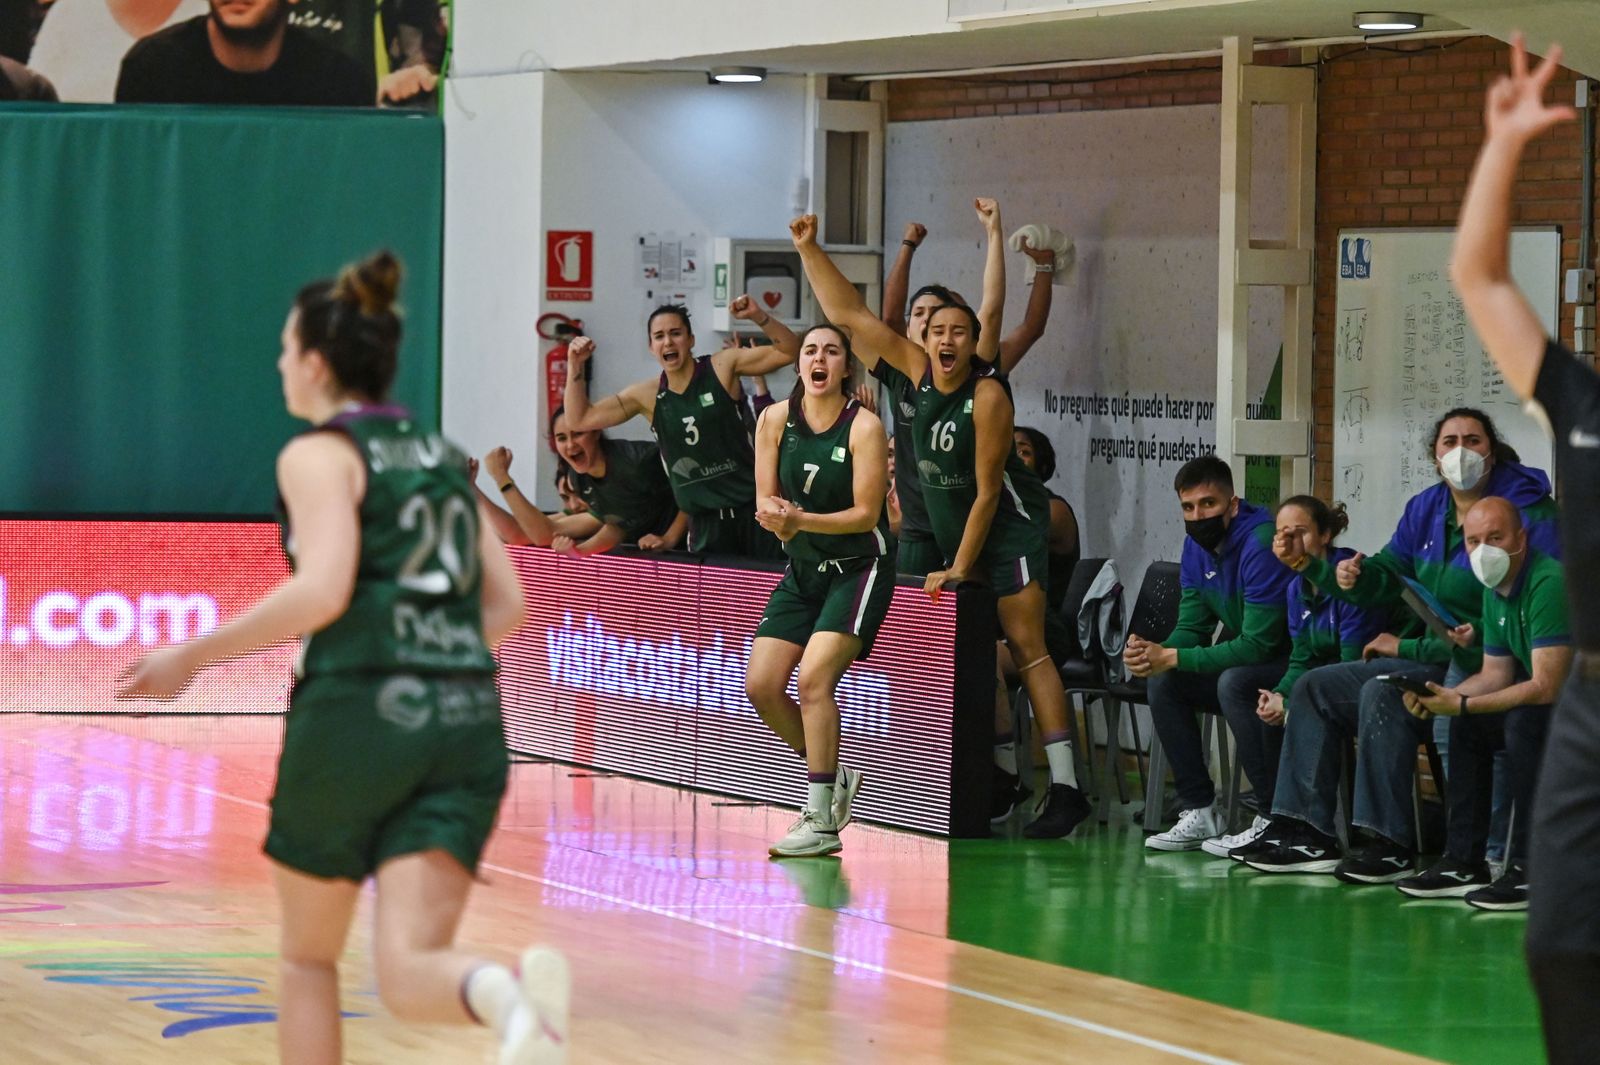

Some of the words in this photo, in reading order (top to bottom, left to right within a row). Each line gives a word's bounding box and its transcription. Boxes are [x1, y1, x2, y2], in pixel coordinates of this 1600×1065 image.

[1045, 389, 1058, 414] No
[1060, 392, 1109, 421] preguntes
[1111, 390, 1130, 423] qué
[1132, 392, 1163, 424] puede
[1165, 393, 1194, 420] hacer
[1196, 400, 1214, 427] por
[682, 416, 699, 446] 3
[930, 420, 957, 452] 16
[1090, 435, 1135, 464] pregunta
[1138, 433, 1157, 466] qué
[1159, 436, 1196, 467] puedes
[803, 463, 820, 494] 7
[398, 494, 478, 596] 20
